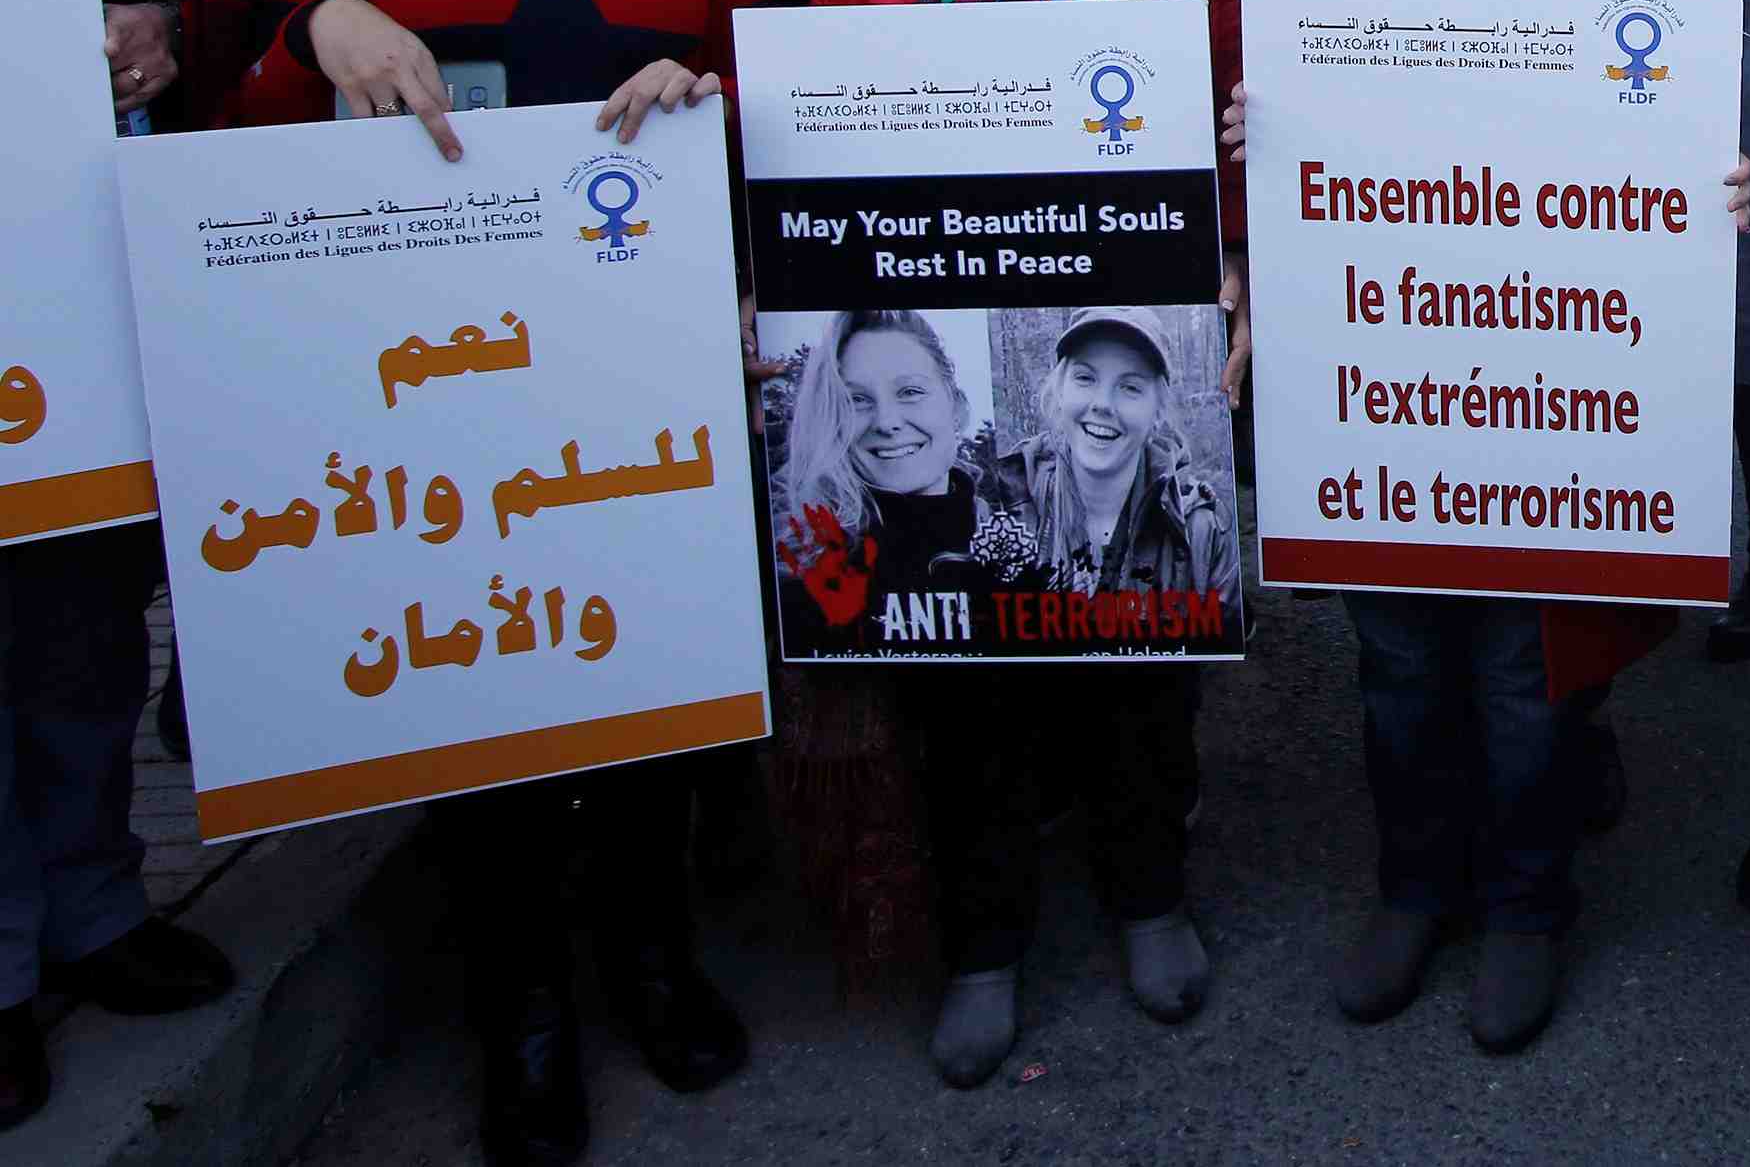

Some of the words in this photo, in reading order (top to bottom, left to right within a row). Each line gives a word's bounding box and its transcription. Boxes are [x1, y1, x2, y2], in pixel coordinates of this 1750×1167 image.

[1303, 54, 1366, 65] Fédération
[1370, 56, 1389, 65] des
[1393, 56, 1432, 68] Ligues
[1436, 57, 1455, 67] des
[1458, 58, 1495, 68] Droits
[1499, 59, 1520, 69] Des
[1525, 60, 1574, 70] Femmes
[1620, 92, 1656, 104] FLDF
[796, 122, 856, 132] Fédération
[860, 122, 878, 130] des
[882, 121, 918, 132] Ligues
[922, 120, 940, 129] des
[943, 119, 978, 129] Droits
[982, 119, 1002, 127] Des
[1006, 118, 1053, 127] Femmes
[1098, 144, 1133, 155] FLDF
[1300, 161, 1520, 227] Ensemble
[1537, 175, 1687, 233] contre
[781, 212, 848, 245] May
[857, 211, 931, 236] Your
[943, 204, 1086, 234] Beautiful
[1099, 203, 1184, 232] Souls
[206, 252, 290, 267] Fédération
[295, 249, 320, 259] des
[324, 245, 373, 257] Ligues
[378, 242, 401, 251] des
[406, 237, 450, 249] Droits
[455, 235, 480, 244] Des
[485, 231, 543, 242] Femmes
[597, 246, 638, 263] FLDF
[876, 252, 946, 277] Rest
[957, 250, 985, 275] In
[998, 250, 1092, 274] Peace
[1346, 265, 1384, 324] le
[1398, 267, 1641, 347] fanatisme,
[378, 311, 531, 409] نعم
[492, 425, 714, 539] للسلم
[1318, 467, 1363, 520] et
[1379, 466, 1416, 522] le
[1430, 471, 1674, 533] terrorisme
[201, 452, 463, 572] والأمن
[344, 575, 616, 697] والأمان
[884, 592, 971, 641] ANTI
[992, 591, 1222, 640] TERRORISM
